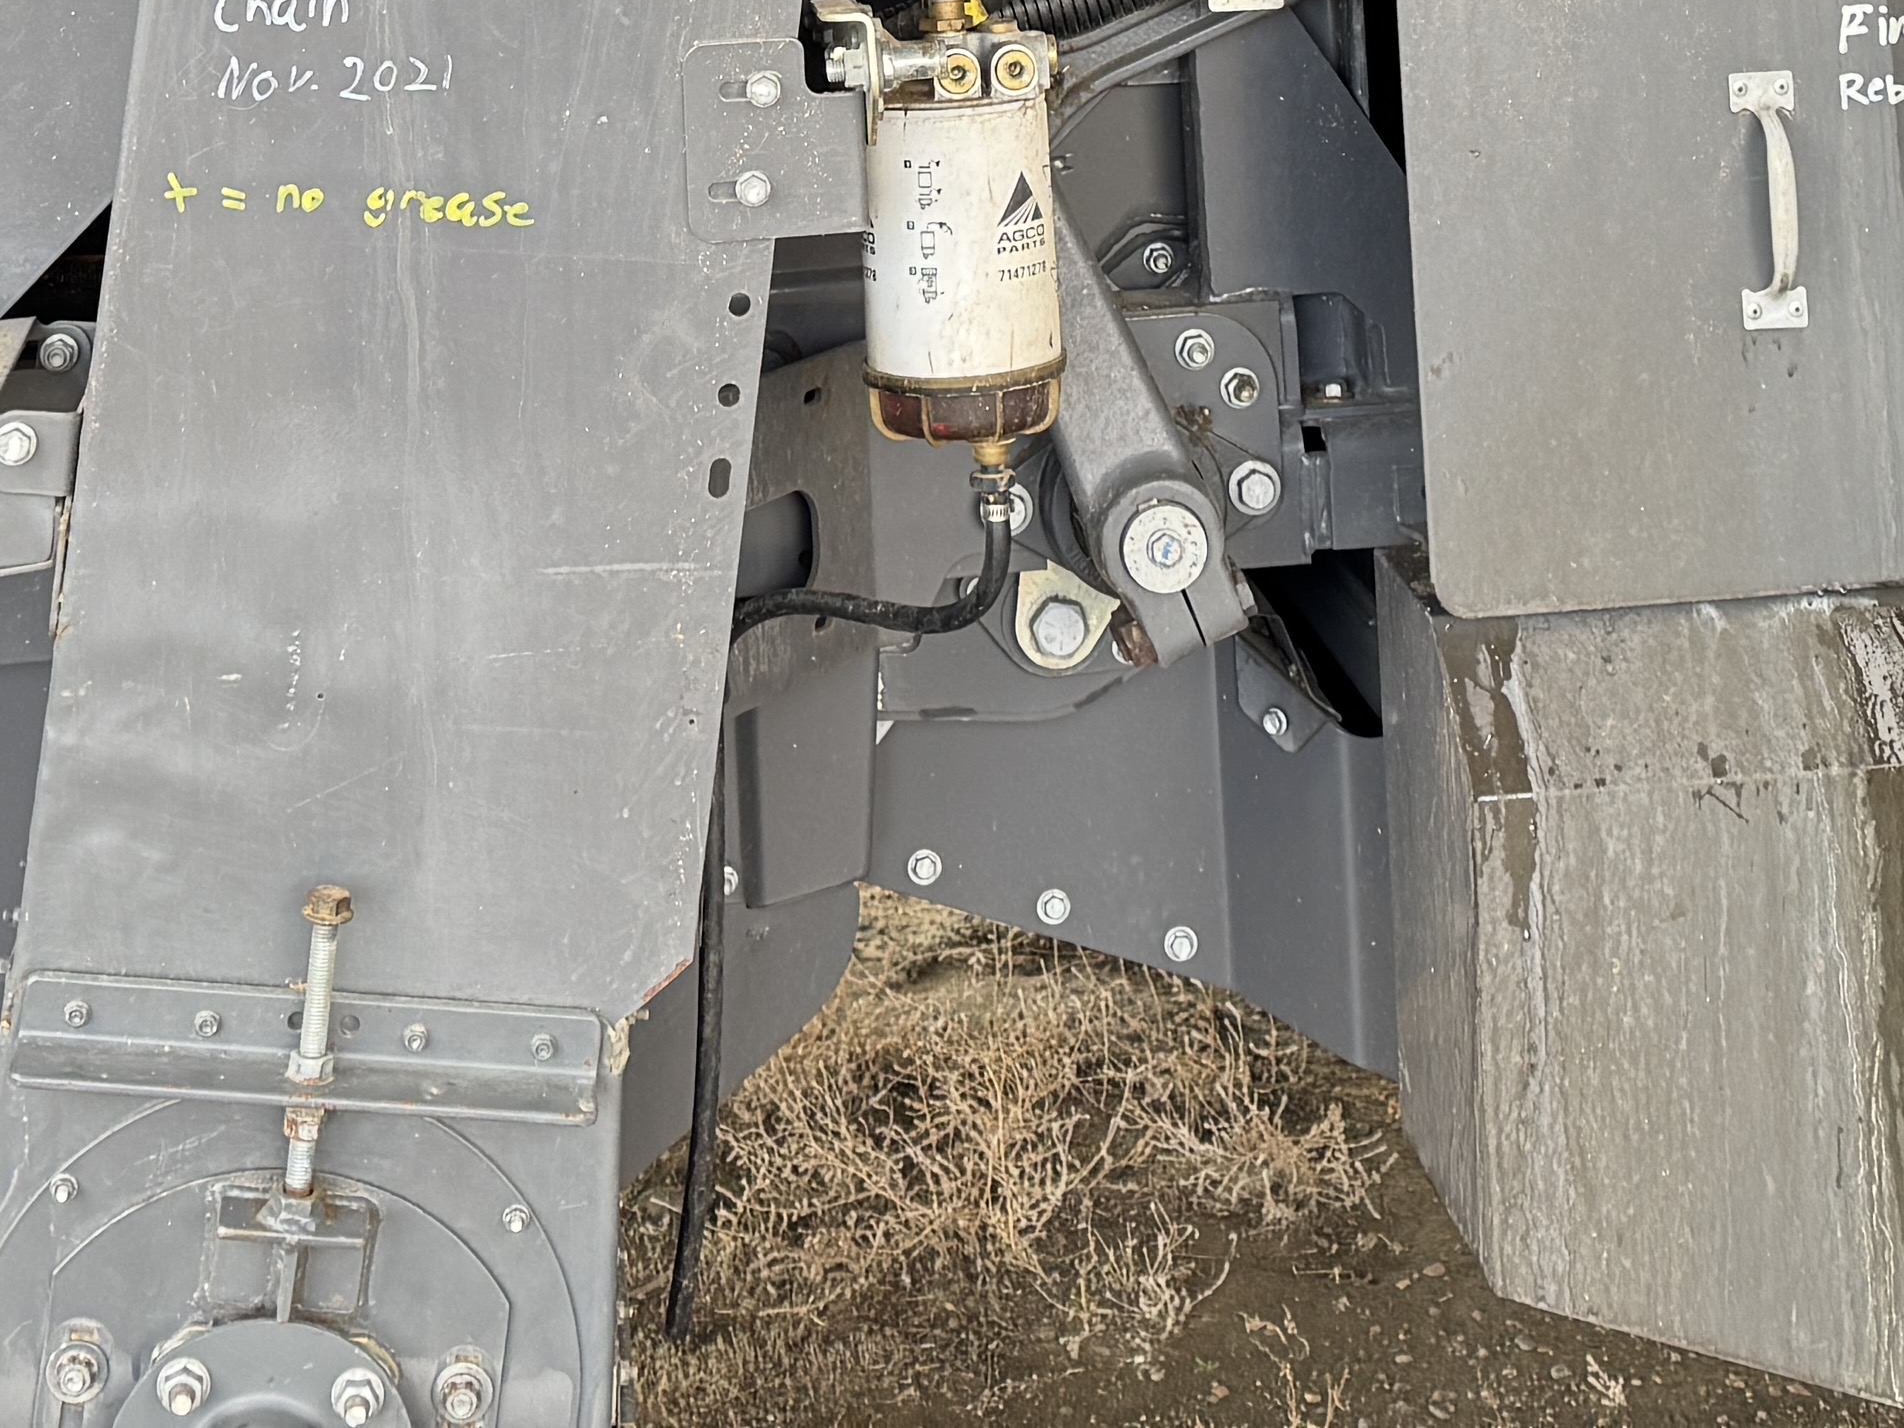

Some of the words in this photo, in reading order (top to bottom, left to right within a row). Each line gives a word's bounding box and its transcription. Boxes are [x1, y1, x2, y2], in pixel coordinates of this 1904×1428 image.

[339, 54, 454, 102] 2021
[275, 183, 326, 214] no
[363, 183, 536, 228] grease
[997, 223, 1045, 245] AGCO
[997, 238, 1046, 255] PARTS
